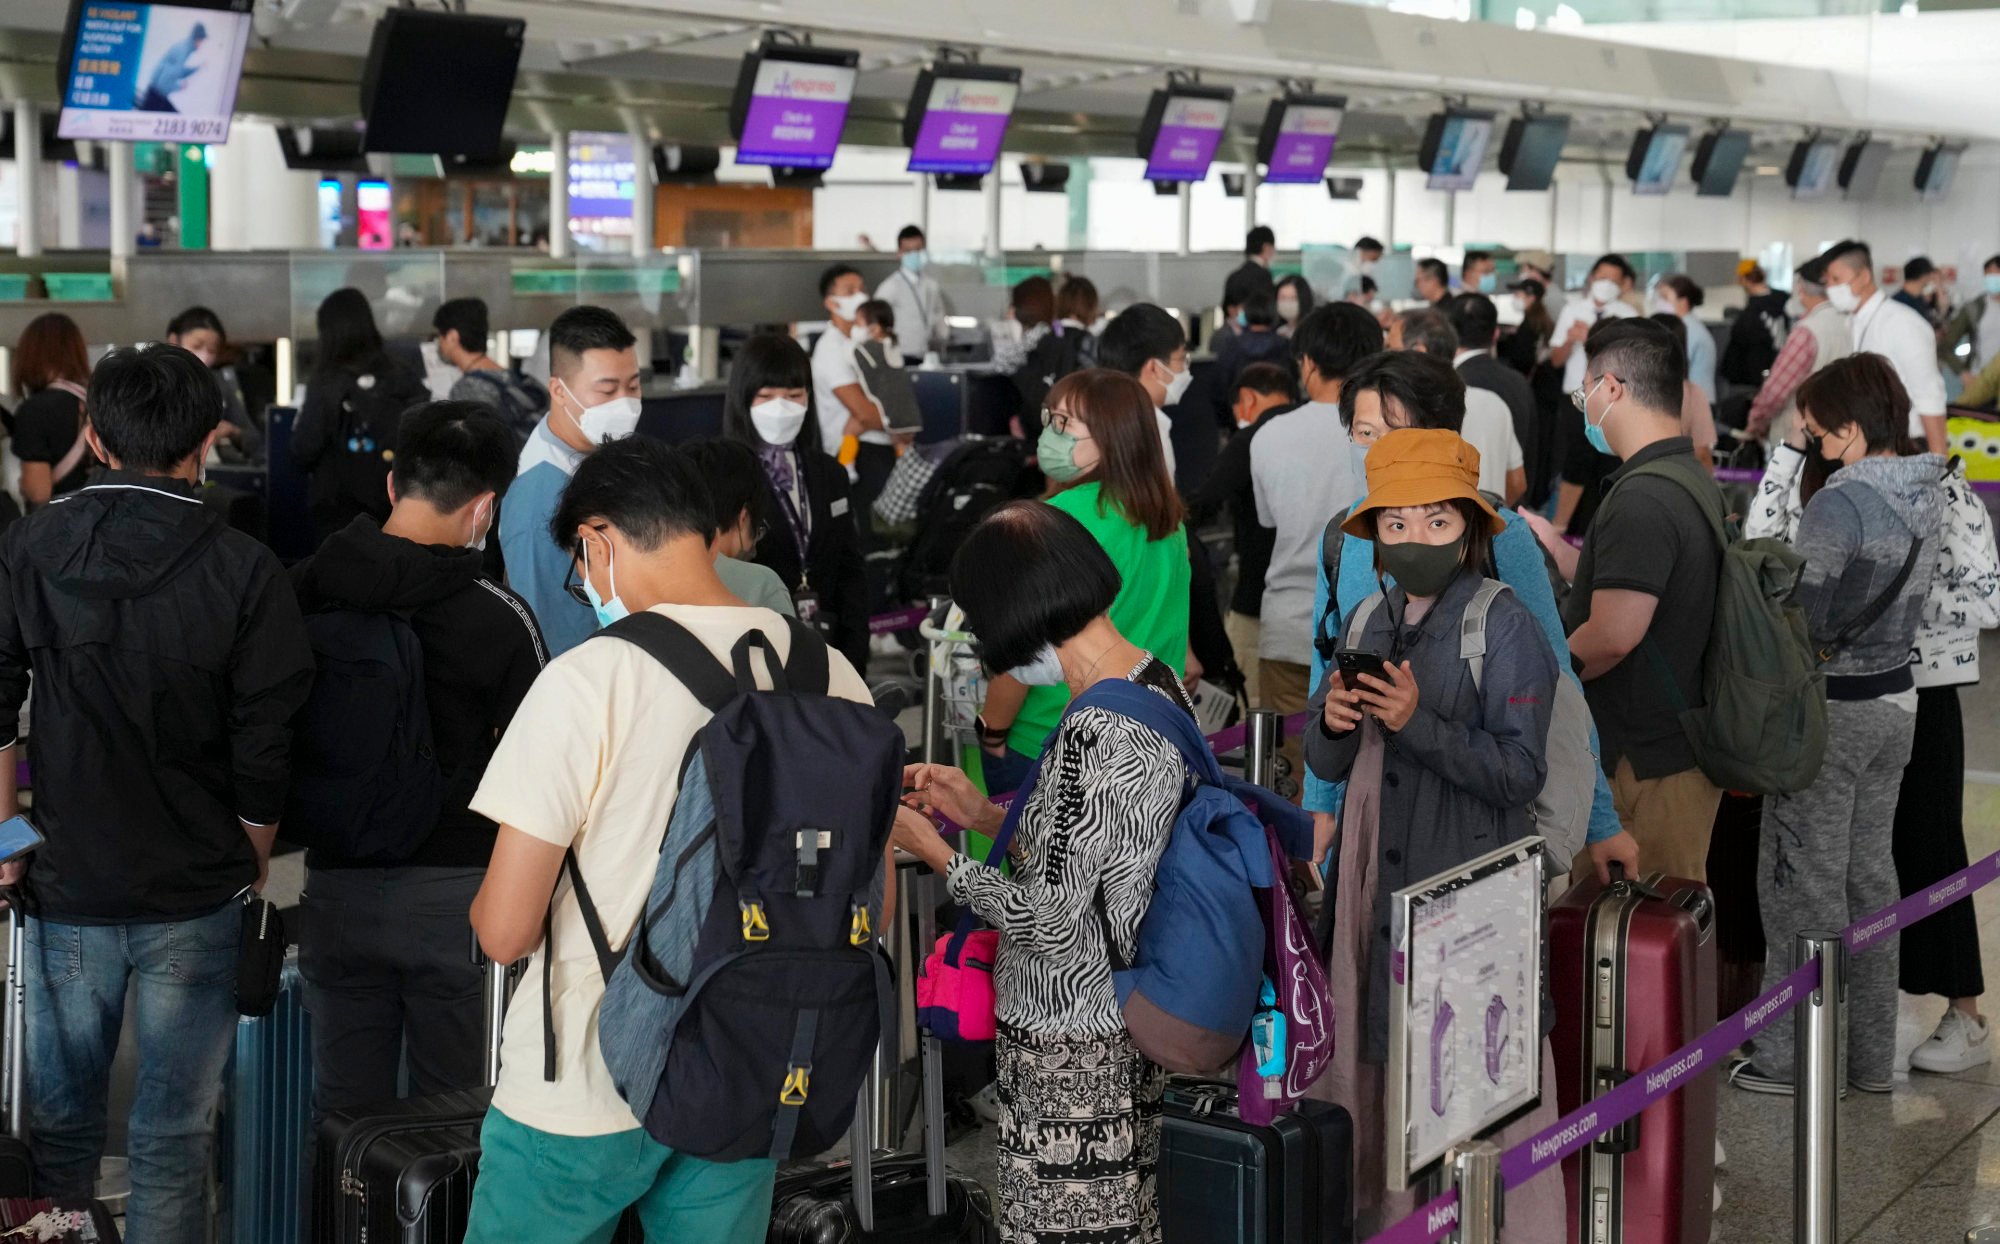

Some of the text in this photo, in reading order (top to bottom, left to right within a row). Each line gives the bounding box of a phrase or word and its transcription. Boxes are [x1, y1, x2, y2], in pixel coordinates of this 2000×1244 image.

[153, 118, 186, 135] 2183
[190, 119, 222, 136] 9074
[1928, 876, 1968, 906] hkexpress.com
[1852, 913, 1897, 945] hkexpress.com
[1744, 984, 1793, 1031] hkexpress.com
[1646, 1048, 1703, 1095] hkexpress.com
[1531, 1111, 1598, 1165] hkexpress.com
